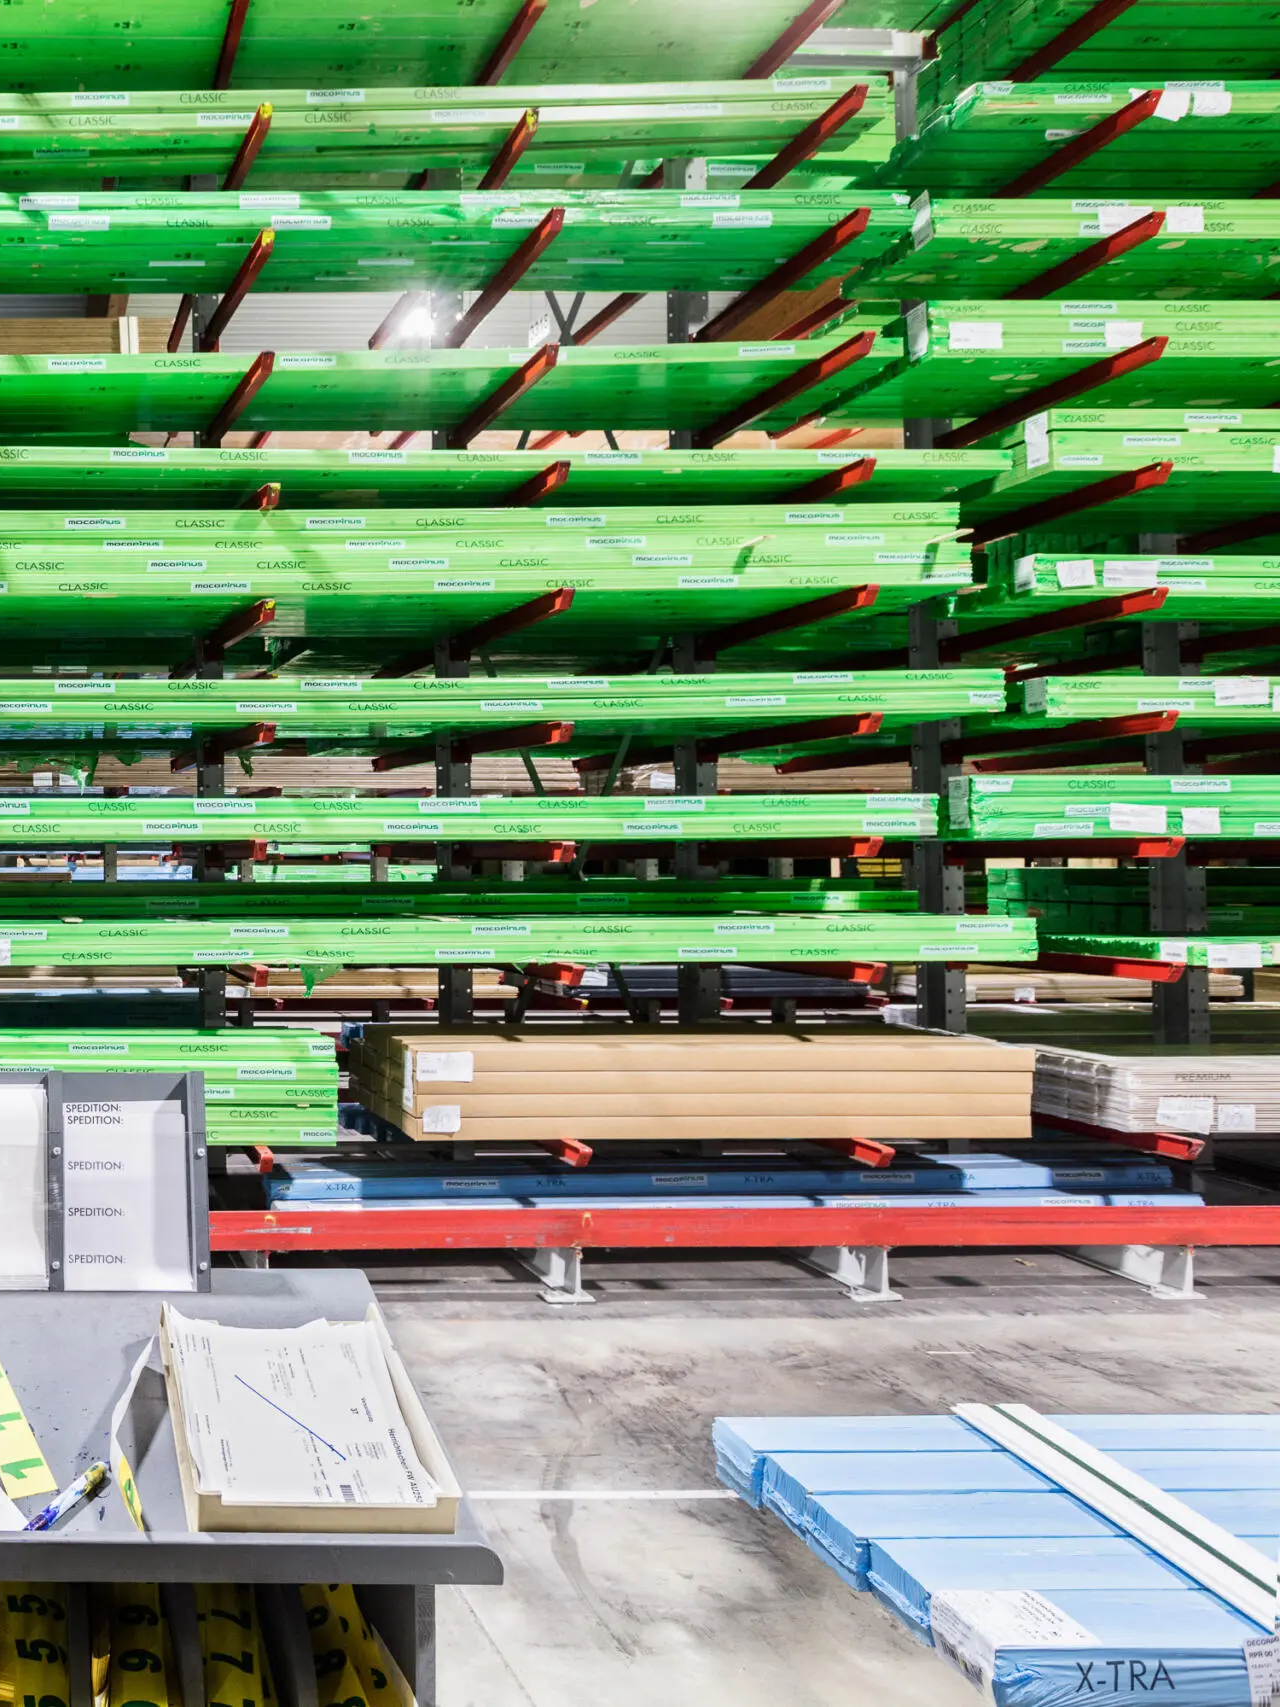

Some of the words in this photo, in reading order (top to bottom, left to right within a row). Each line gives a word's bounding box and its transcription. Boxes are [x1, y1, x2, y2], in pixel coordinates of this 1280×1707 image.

[74, 93, 127, 103] mocopinus
[179, 92, 227, 104] CLASSIC
[771, 101, 818, 111] CLASSIC
[68, 115, 117, 127] CLASSIC
[200, 112, 252, 122] mocopinus
[304, 111, 352, 123] CLASSIC
[793, 193, 841, 204] CLASSIC
[1164, 304, 1211, 313] CLASSIC
[1175, 321, 1222, 331] CLASSIC
[1168, 341, 1215, 350] CLASSIC
[112, 449, 165, 458] mocopinus
[219, 451, 268, 461] CLASSIC
[656, 514, 704, 524] CLASSIC
[893, 511, 938, 521] CLASSIC
[67, 518, 120, 526] mocopinus
[416, 517, 465, 527] CLASSIC
[15, 561, 64, 572] CLASSIC
[256, 560, 306, 570] CLASSIC
[58, 582, 108, 592] CLASSIC
[302, 582, 352, 591] CLASSIC
[58, 681, 112, 690] mocopinus
[304, 680, 357, 688] mocopinus
[104, 702, 154, 712] CLASSIC
[348, 702, 398, 712] CLASSIC
[1067, 780, 1116, 790] CLASSIC
[88, 801, 137, 812] CLASSIC
[420, 800, 477, 809] mocopinus
[12, 823, 60, 833] CLASSIC
[145, 821, 199, 831] mocopinus
[253, 823, 302, 834] CLASSIC
[387, 822, 439, 831] mocopinus
[626, 822, 679, 831] mocopinus
[733, 822, 781, 833] CLASSIC
[341, 926, 391, 936] CLASSIC
[583, 925, 632, 934] CLASSIC
[717, 923, 771, 931] mocopinus
[826, 923, 874, 933] CLASSIC
[790, 948, 839, 956] CLASSIC
[180, 1044, 228, 1052] CLASSIC
[240, 1068, 292, 1076] mocopinus
[65, 1103, 122, 1113] SPEDITION:
[230, 1110, 278, 1119] CLASSIC
[67, 1116, 124, 1125] SPEDITION:
[67, 1161, 125, 1171] SPEDITION:
[325, 1183, 355, 1192] X-TRA
[68, 1207, 126, 1218] SPEDITION:
[68, 1255, 126, 1265] SPEDITION:
[0, 1457, 44, 1480] 1
[7, 1593, 49, 1616] 5
[211, 1609, 252, 1631] 7
[15, 1638, 61, 1665] 5
[120, 1648, 163, 1673] 6
[210, 1651, 253, 1674] 7
[1075, 1660, 1175, 1693] X-TRA
